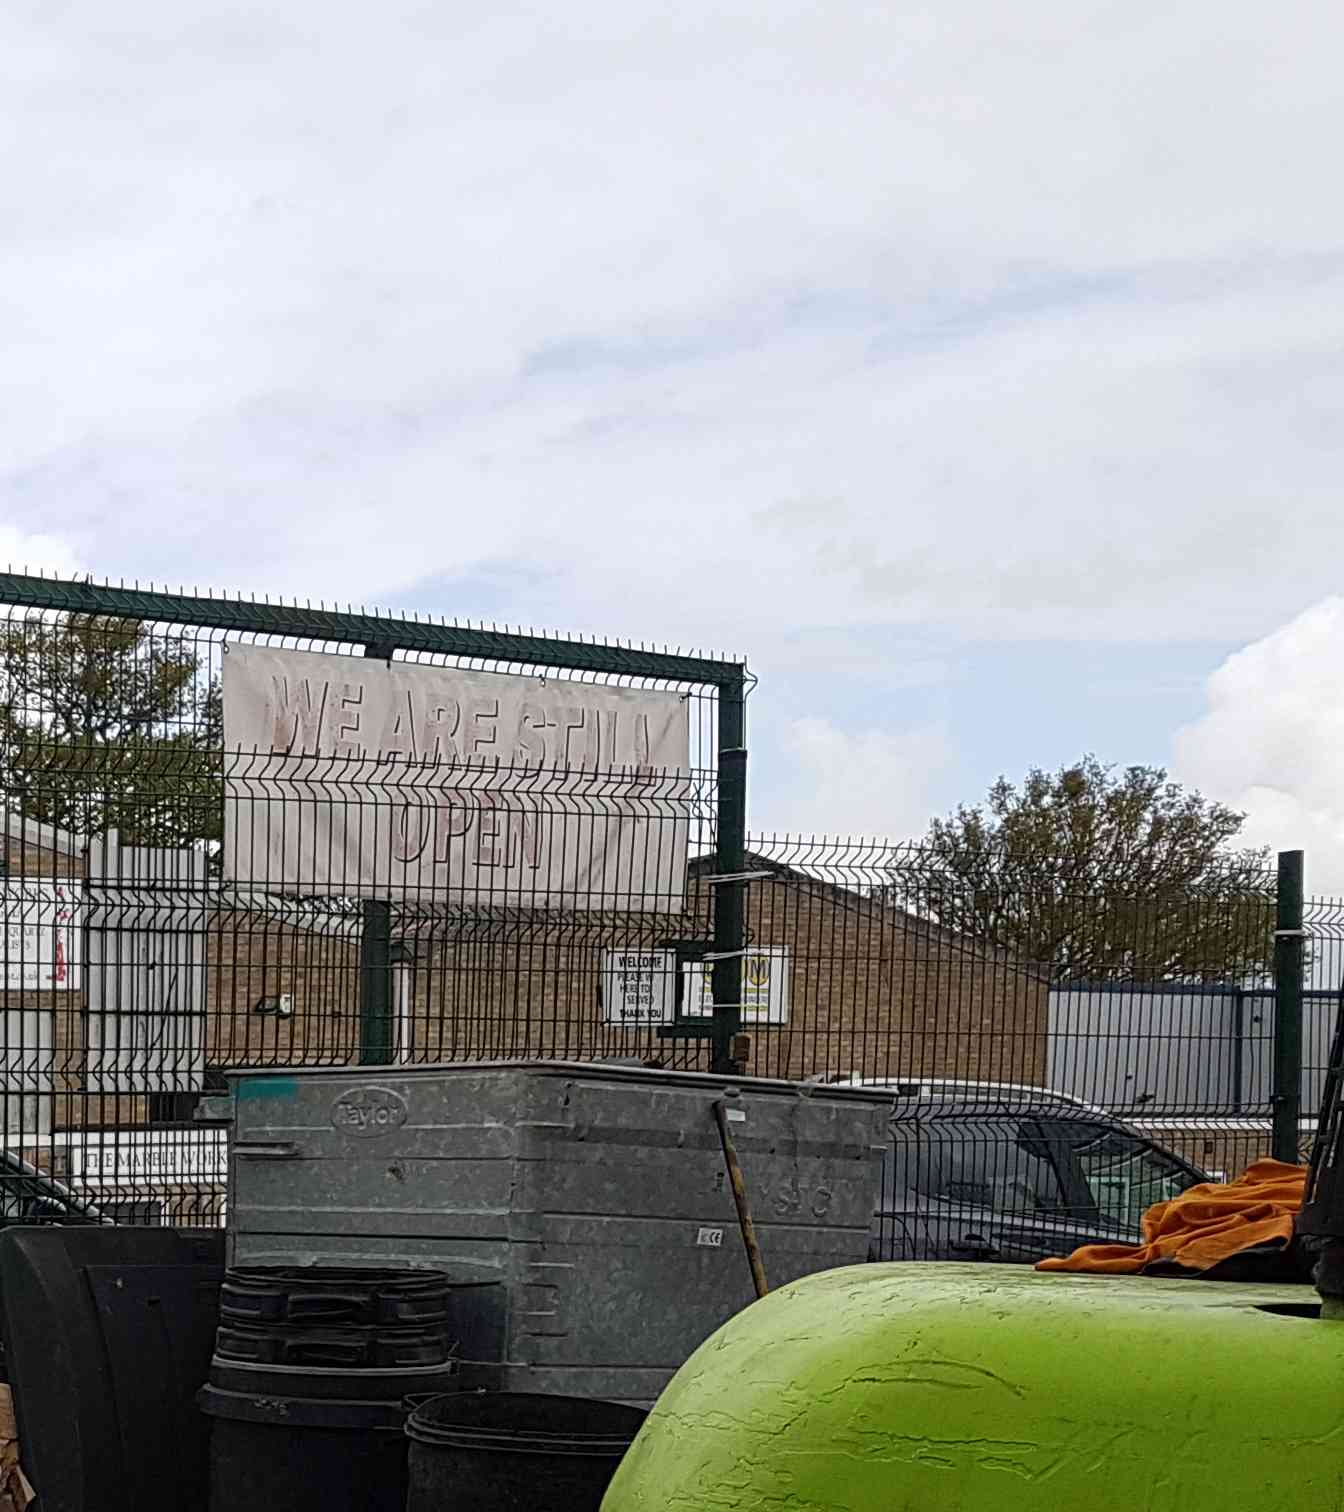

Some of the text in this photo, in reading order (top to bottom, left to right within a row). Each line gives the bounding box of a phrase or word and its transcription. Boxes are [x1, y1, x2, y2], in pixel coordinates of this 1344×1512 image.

[270, 674, 658, 787] WE ARE STILL
[392, 790, 545, 870] OPEN
